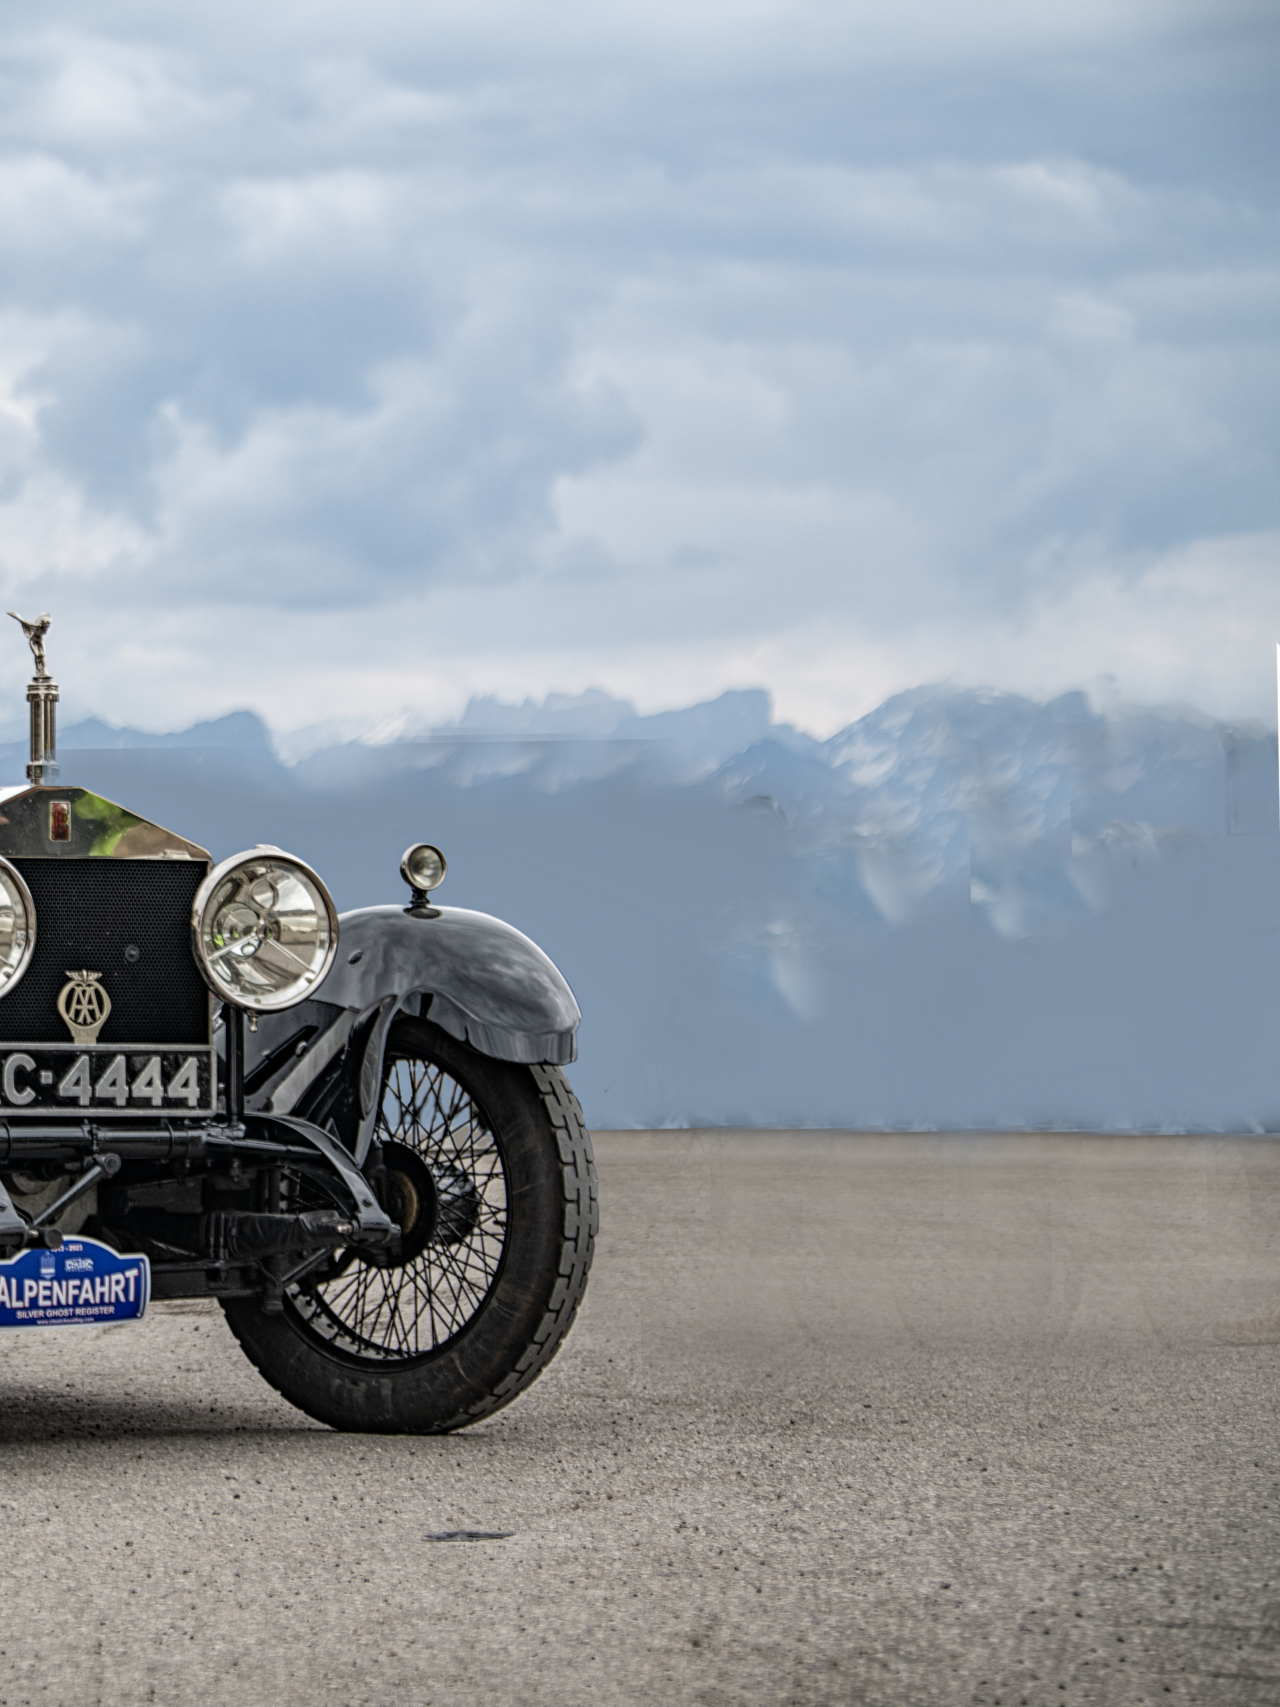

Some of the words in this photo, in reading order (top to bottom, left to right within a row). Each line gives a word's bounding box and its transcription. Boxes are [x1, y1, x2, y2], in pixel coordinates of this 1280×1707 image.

[68, 1243, 83, 1252] 2023
[16, 1310, 44, 1319] SILVER
[46, 1308, 74, 1318] GHOST
[75, 1306, 115, 1316] REGISTER
